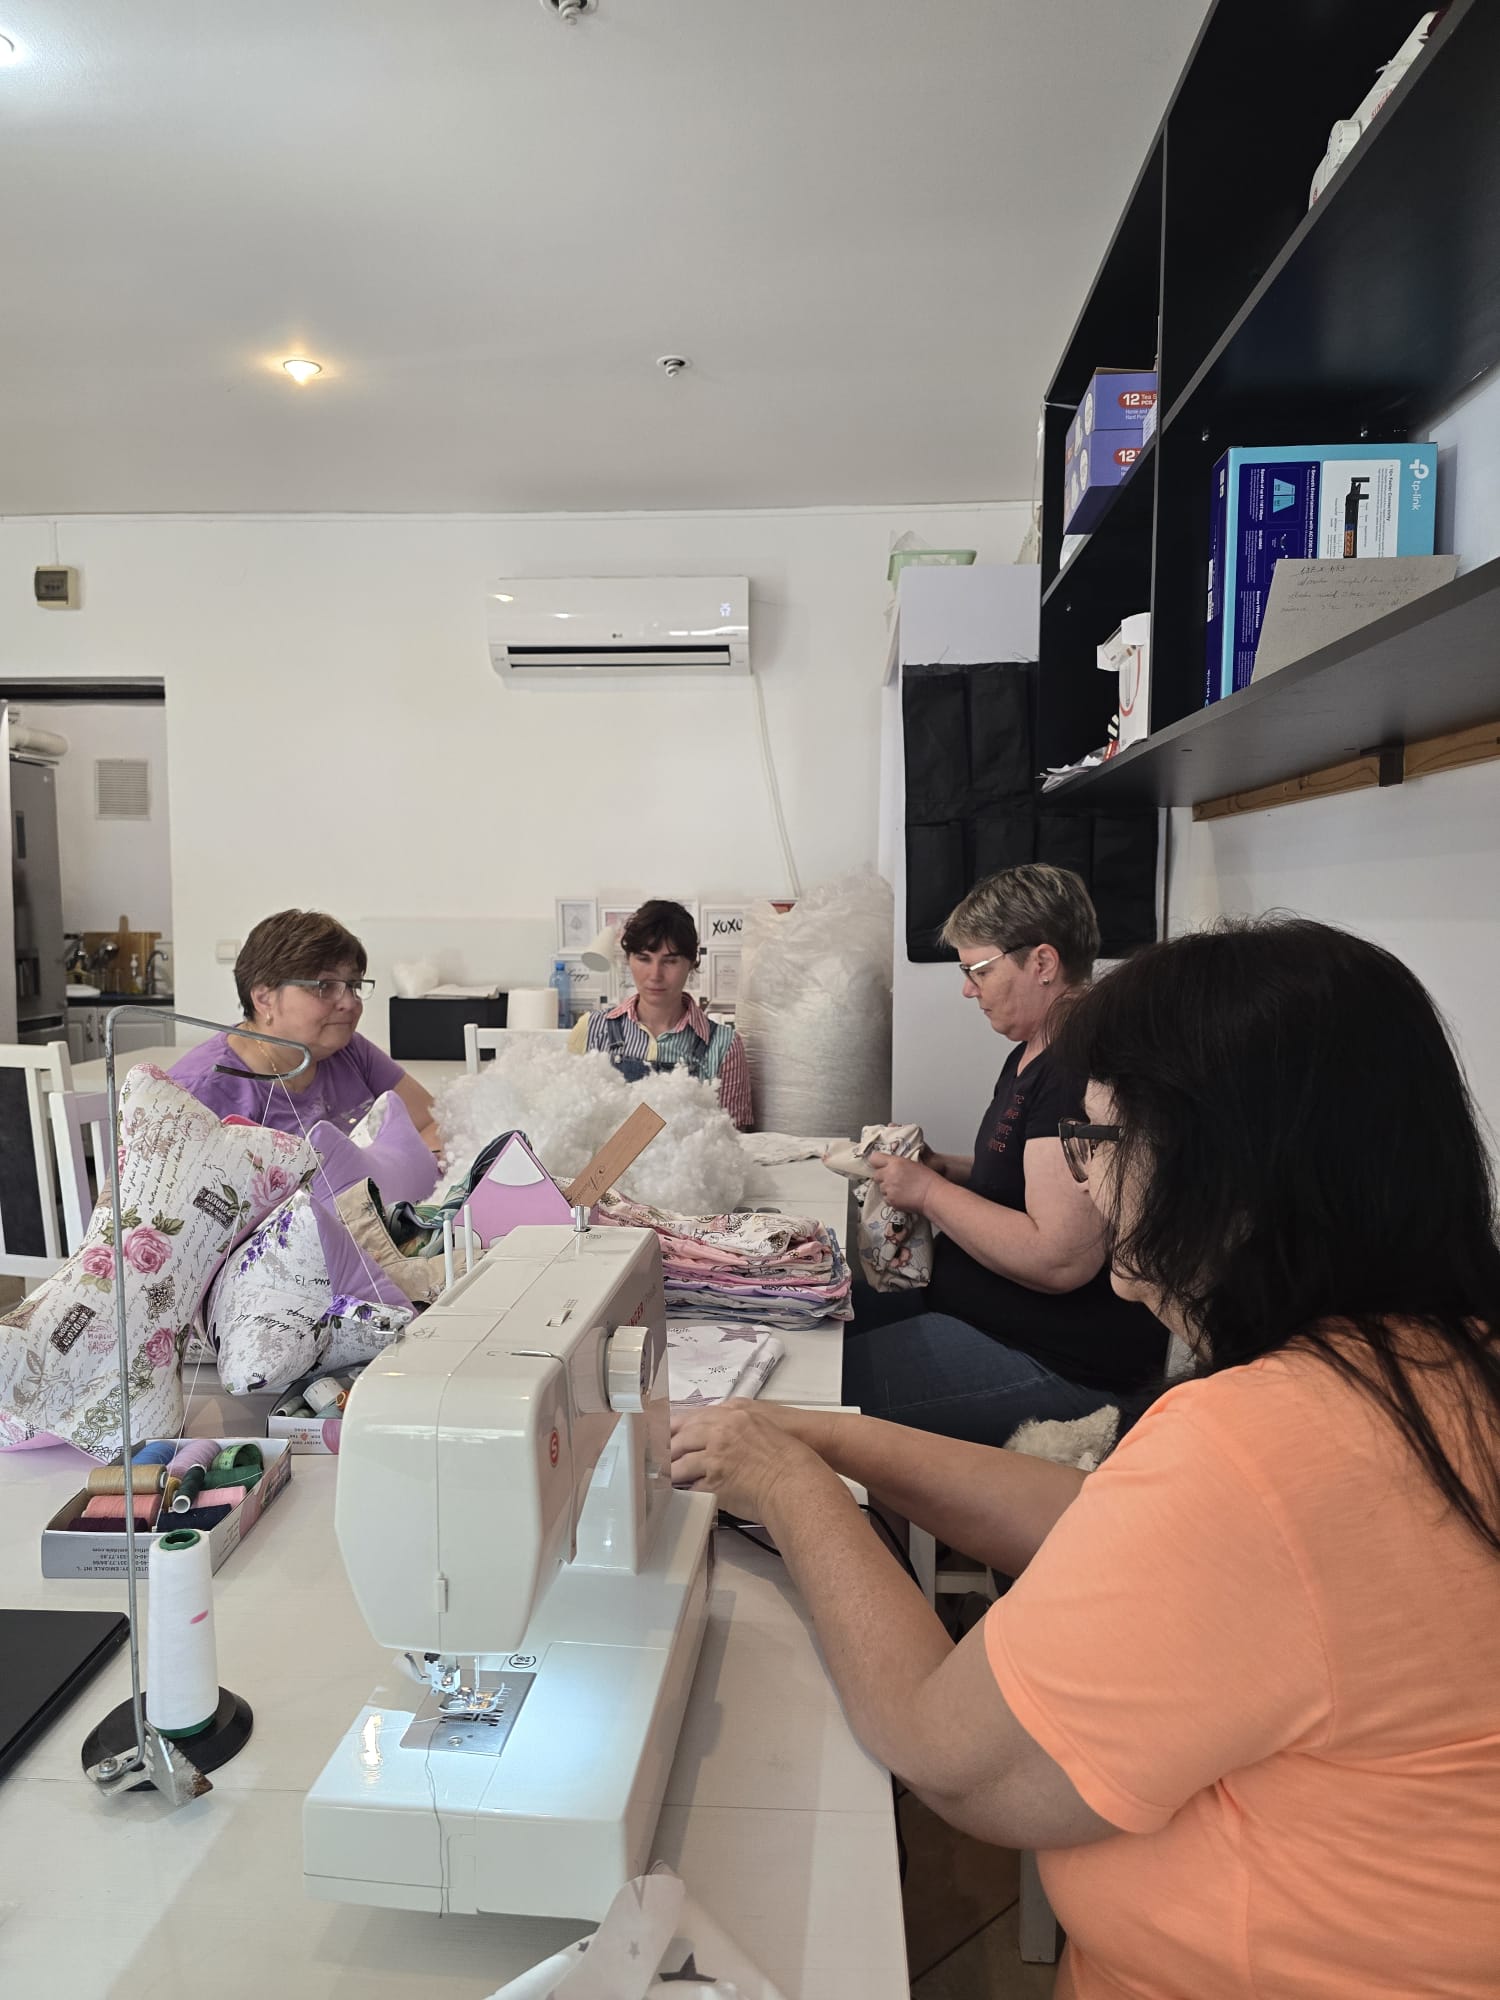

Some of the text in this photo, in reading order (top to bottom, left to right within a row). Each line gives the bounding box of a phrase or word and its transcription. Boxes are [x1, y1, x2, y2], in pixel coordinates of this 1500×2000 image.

[1122, 393, 1140, 406] 12
[1118, 449, 1136, 462] 12
[1411, 479, 1421, 511] tp-link
[712, 919, 743, 936] XOXO
